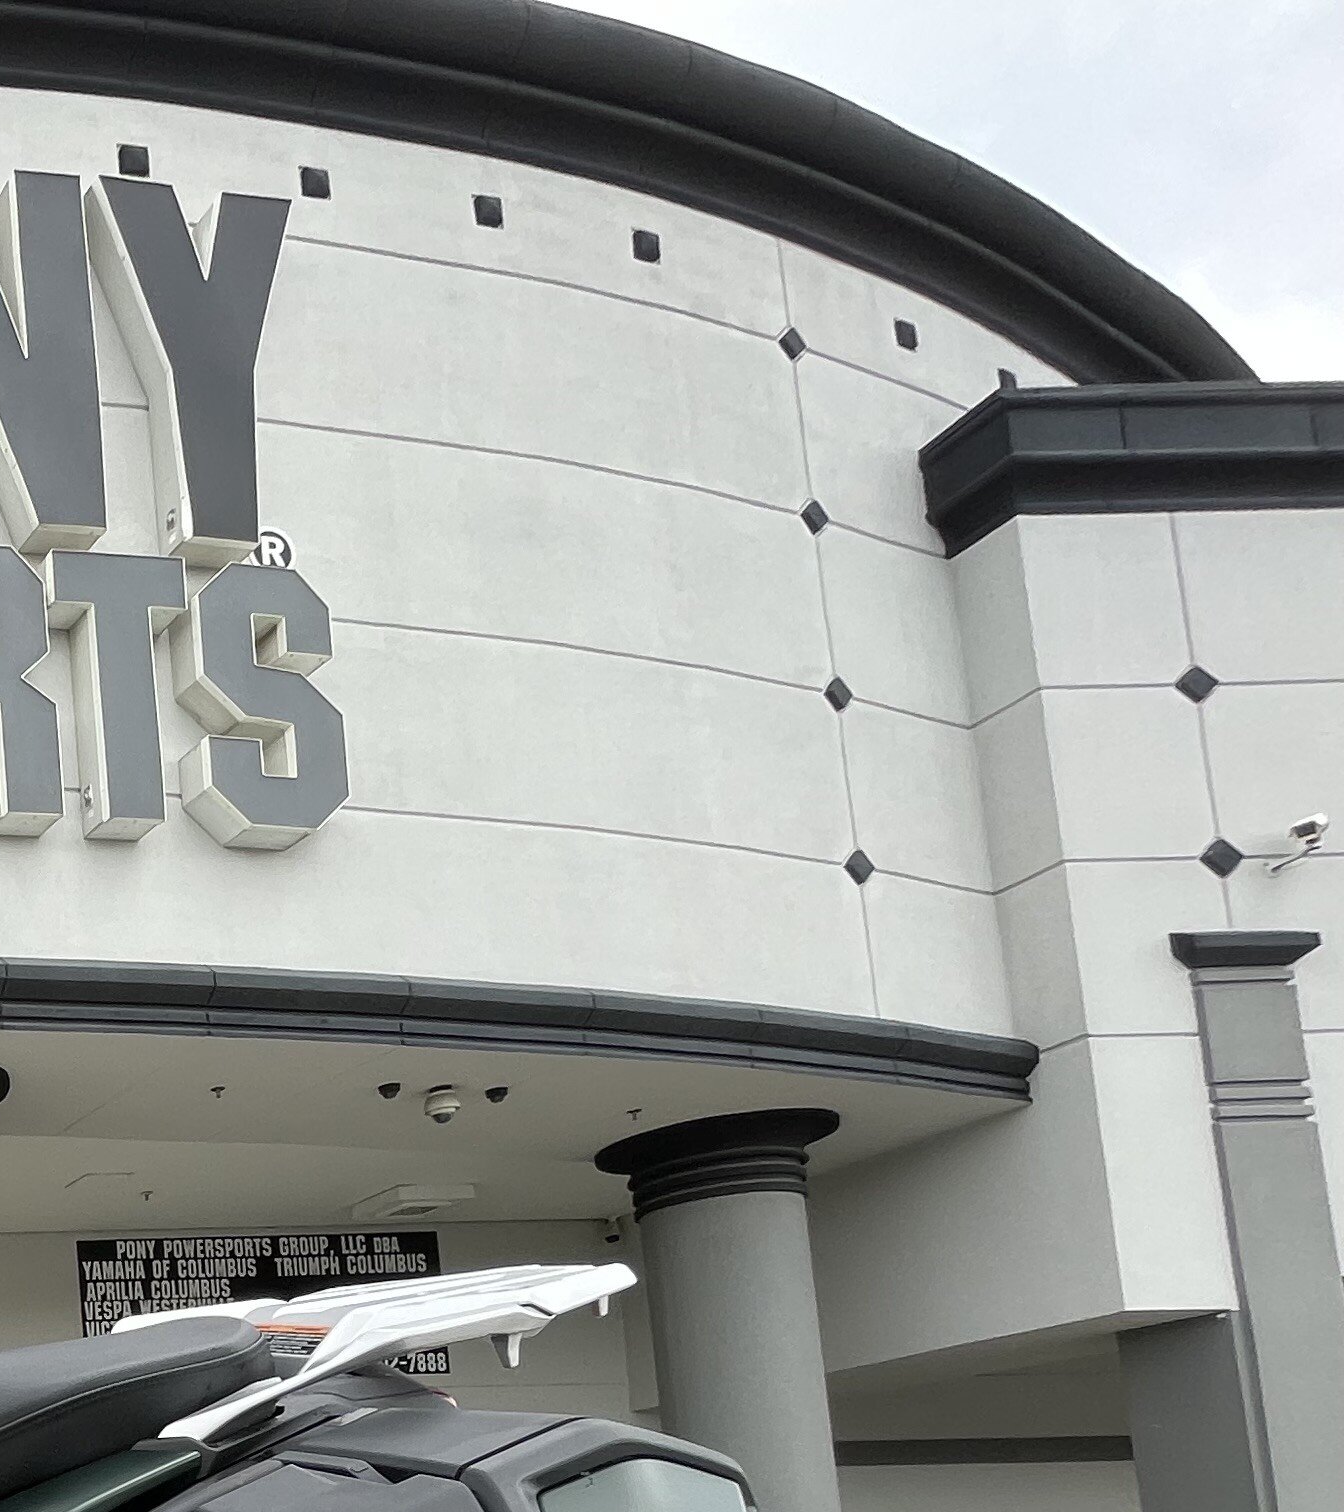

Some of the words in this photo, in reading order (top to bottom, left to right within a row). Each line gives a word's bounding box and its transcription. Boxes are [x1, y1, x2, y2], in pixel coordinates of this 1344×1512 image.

[115, 1239, 156, 1260] PONY
[162, 1236, 272, 1259] POWERSPORTS
[278, 1236, 334, 1257] GROUP,
[340, 1235, 367, 1255] LLC
[373, 1236, 401, 1254] DBA
[81, 1259, 146, 1281] YAMAHA
[152, 1259, 171, 1279] OF
[177, 1258, 258, 1279] COLUMBUS
[274, 1255, 341, 1277] TRIUMPH
[345, 1253, 428, 1275] COLUMBUS
[86, 1280, 145, 1302] APRILIA
[150, 1278, 232, 1300] COLUMBUS
[83, 1300, 133, 1321] VESPA
[84, 1320, 115, 1338] VIC
